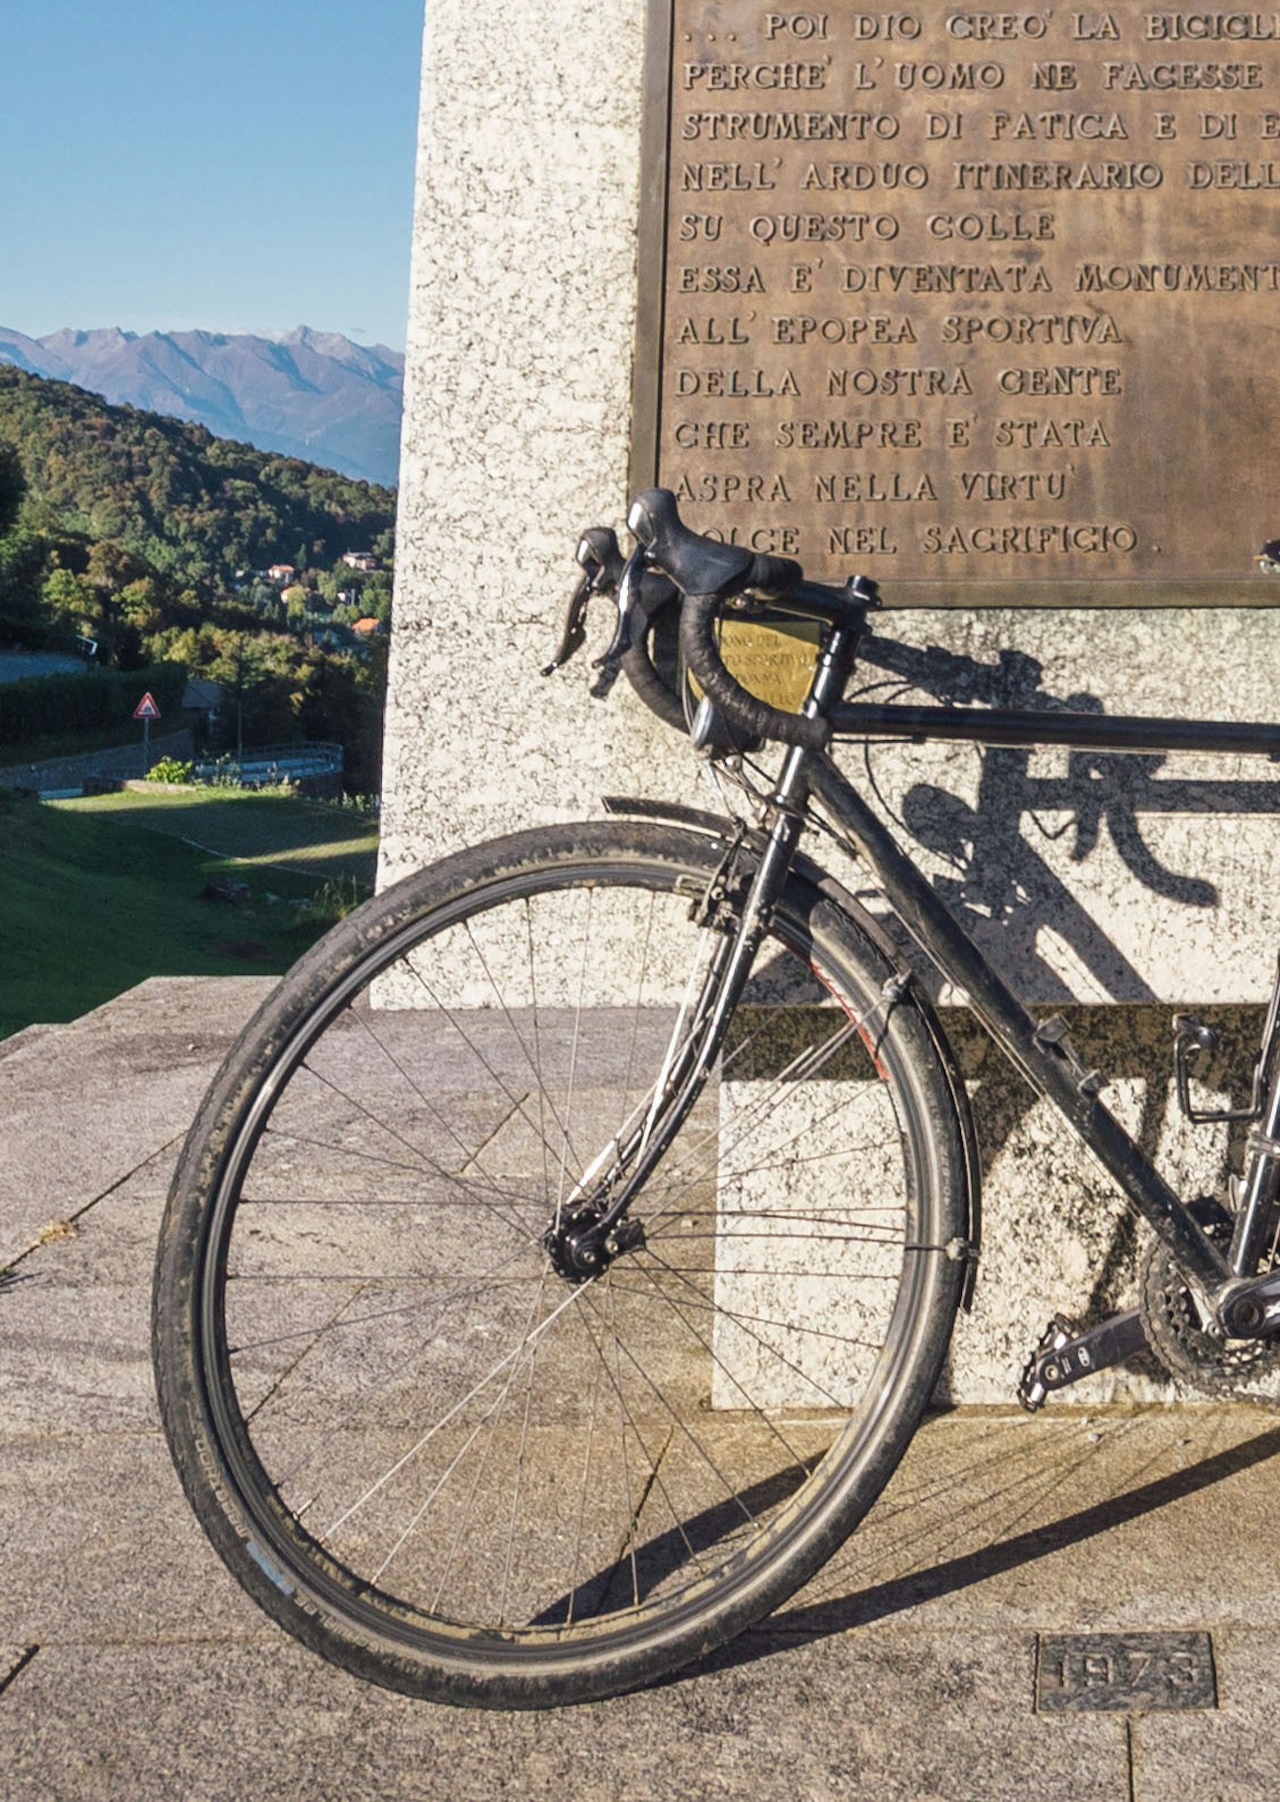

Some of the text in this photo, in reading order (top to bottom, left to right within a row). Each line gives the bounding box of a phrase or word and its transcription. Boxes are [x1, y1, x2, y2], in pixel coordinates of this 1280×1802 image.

[764, 13, 830, 41] POI
[854, 13, 923, 42] DIO
[1072, 13, 1120, 41] LA
[1030, 63, 1078, 91] NE
[1103, 63, 1264, 91] FACESSE
[682, 112, 900, 141] STRUMENTO
[925, 112, 963, 141] DI
[989, 112, 1129, 141] FATICA
[1155, 112, 1177, 141] E
[1199, 112, 1238, 141] DI
[953, 162, 1164, 191] ITINERARIO
[679, 214, 1056, 246] SU QUESTO COLLE
[677, 265, 766, 294] ESSA
[841, 265, 1052, 294] DIVENTATA
[941, 315, 1124, 345] SPORTIVA
[675, 367, 1122, 398] DELLA NOSTRA GENTE
[675, 420, 750, 449] CHE
[774, 420, 922, 449] SEMPRE
[995, 419, 1111, 448] STATA
[675, 473, 791, 503] ASPRA
[815, 473, 938, 502] NELLA
[701, 526, 800, 555] OLCE
[827, 526, 897, 555] NEL
[1058, 1651, 1199, 1688] 1973
